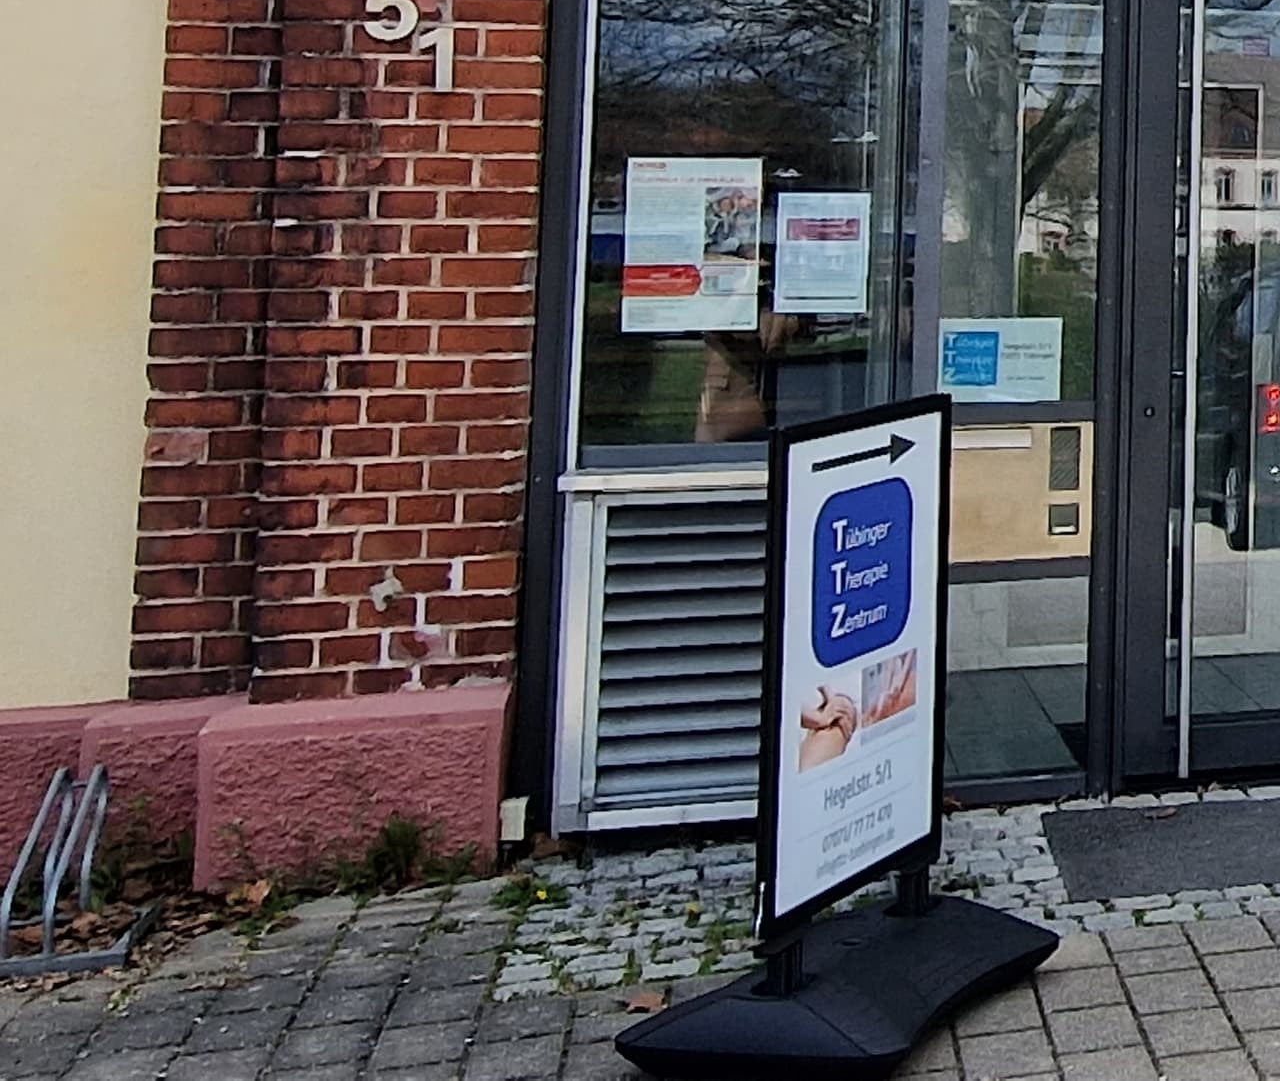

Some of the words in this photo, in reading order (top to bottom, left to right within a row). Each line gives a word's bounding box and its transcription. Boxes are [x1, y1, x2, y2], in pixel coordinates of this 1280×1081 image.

[832, 518, 892, 552] Tübinger
[831, 560, 889, 595] Therapie
[830, 603, 887, 639] Zentrum
[824, 772, 873, 811] Hegelstr.
